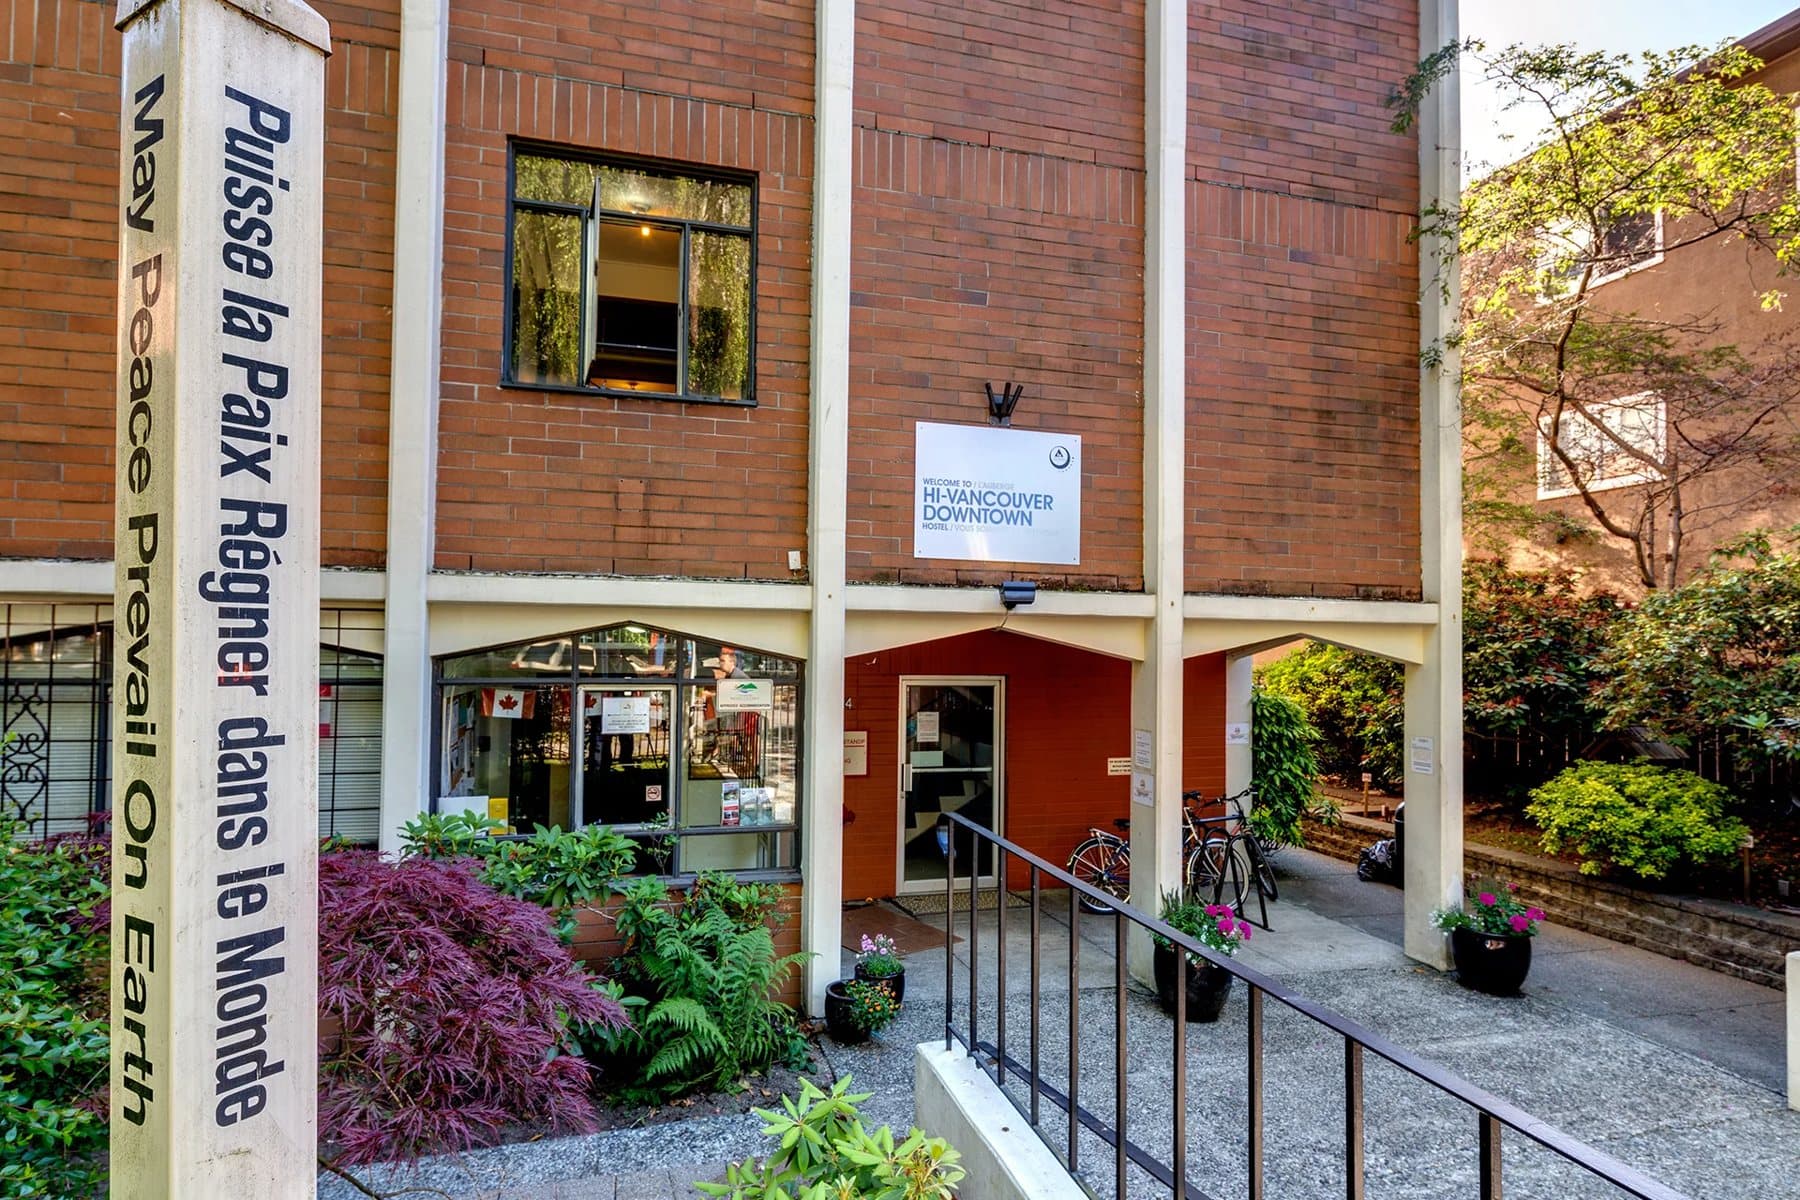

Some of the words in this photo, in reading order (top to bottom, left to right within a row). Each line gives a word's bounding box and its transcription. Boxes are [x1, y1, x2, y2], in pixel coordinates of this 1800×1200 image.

[127, 73, 165, 233] May
[223, 84, 291, 280] Puisse
[128, 253, 163, 495] Peace
[221, 288, 290, 343] la
[220, 353, 289, 484] Paix
[922, 478, 961, 488] WELCOME
[962, 479, 972, 488] TO
[922, 522, 949, 531] HOSTEL
[923, 486, 1054, 511] HI-VANCOUVER
[923, 504, 1033, 527] DOWNTOWN
[125, 513, 159, 758] Prevail
[198, 498, 288, 697] Régner
[124, 780, 157, 890] On
[217, 718, 286, 851] dans
[216, 863, 285, 920] le
[123, 914, 155, 1127] Earth
[215, 927, 285, 1127] Monde
